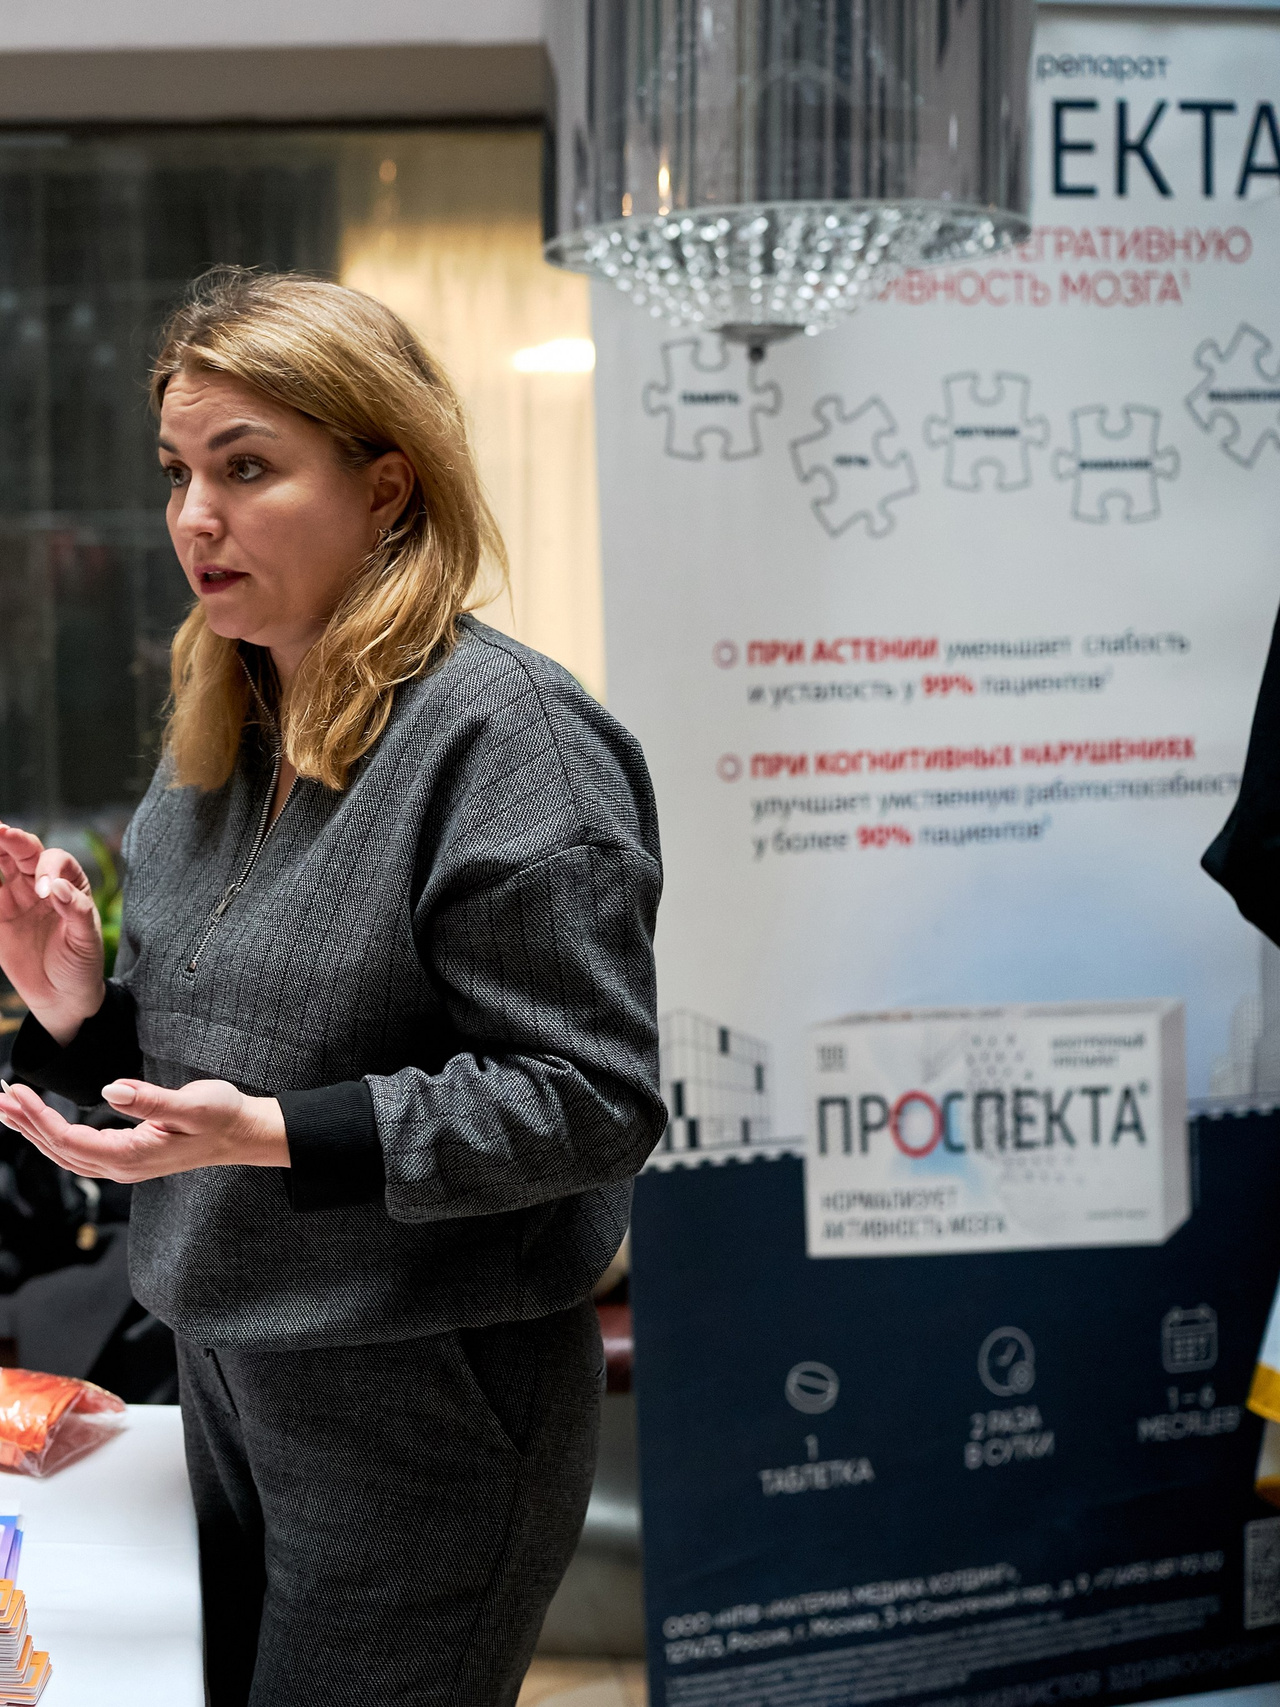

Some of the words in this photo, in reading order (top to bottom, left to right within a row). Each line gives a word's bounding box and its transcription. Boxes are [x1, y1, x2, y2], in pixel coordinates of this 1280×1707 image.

[1037, 54, 1169, 84] репарат
[1052, 98, 1280, 198] ЕКТА
[748, 639, 805, 665] ПРИ
[811, 636, 938, 663] АСТЕНИИ
[922, 675, 976, 698] 99%
[751, 752, 808, 778] ПРИ
[857, 825, 913, 849] 90%
